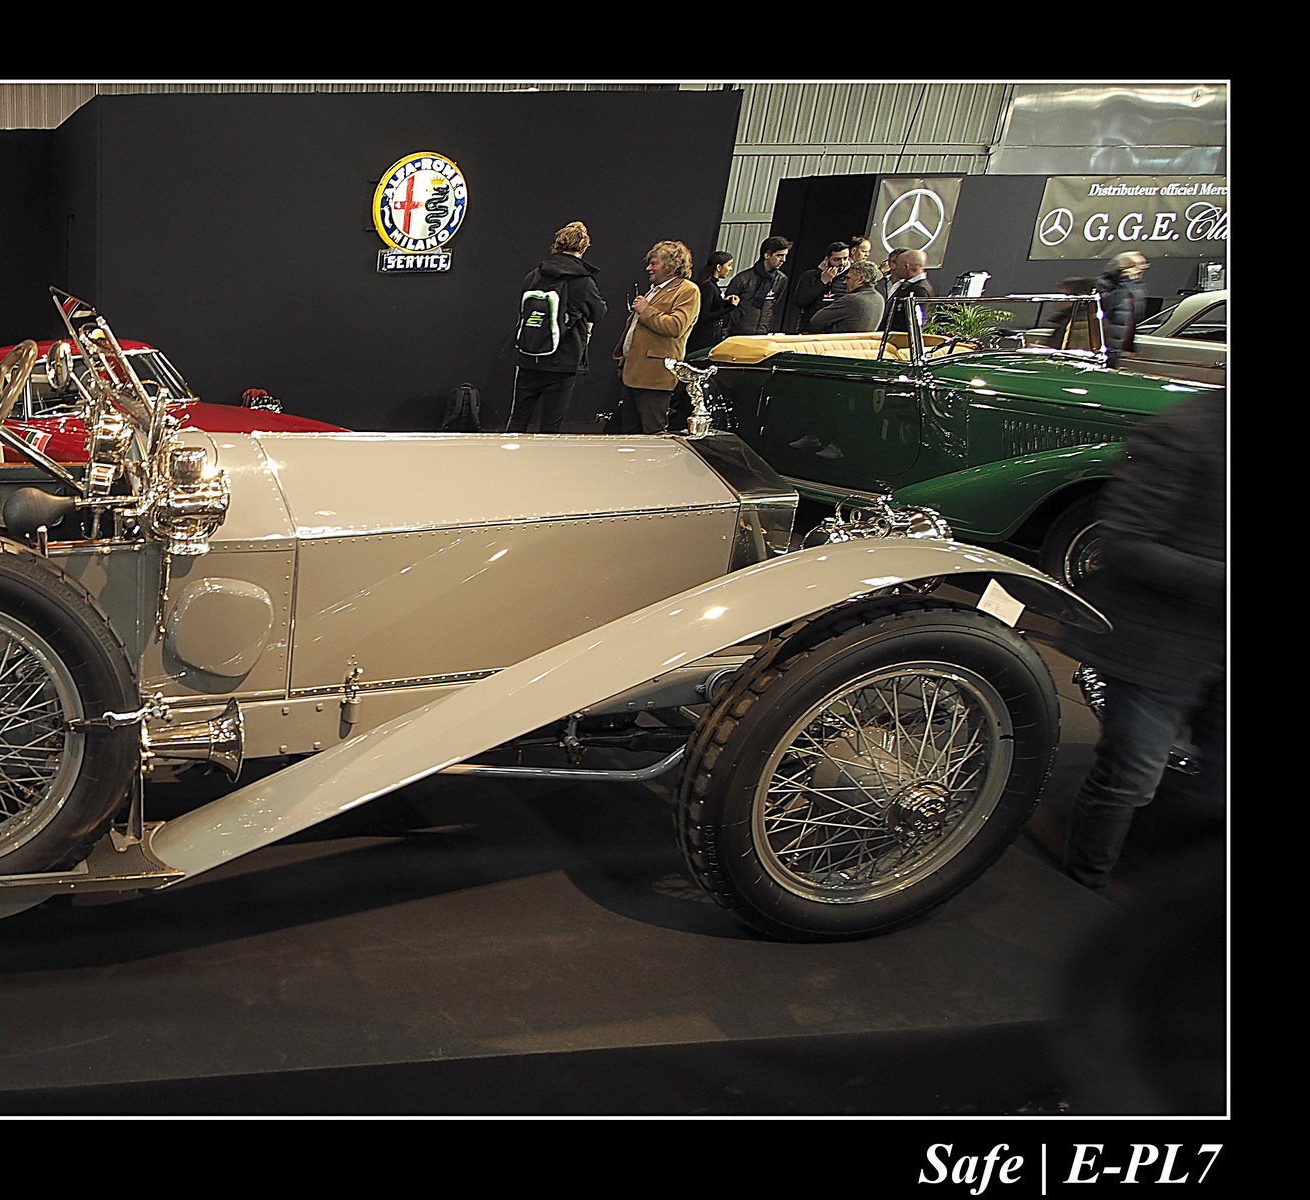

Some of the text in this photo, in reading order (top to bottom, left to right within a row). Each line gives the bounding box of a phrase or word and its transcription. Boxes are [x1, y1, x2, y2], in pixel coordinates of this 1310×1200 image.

[1088, 183, 1159, 197] Distributeur
[1160, 183, 1197, 196] officiel
[1083, 212, 1180, 242] G.G.E.
[389, 229, 450, 250] MILANO
[386, 255, 450, 270] SERVICE
